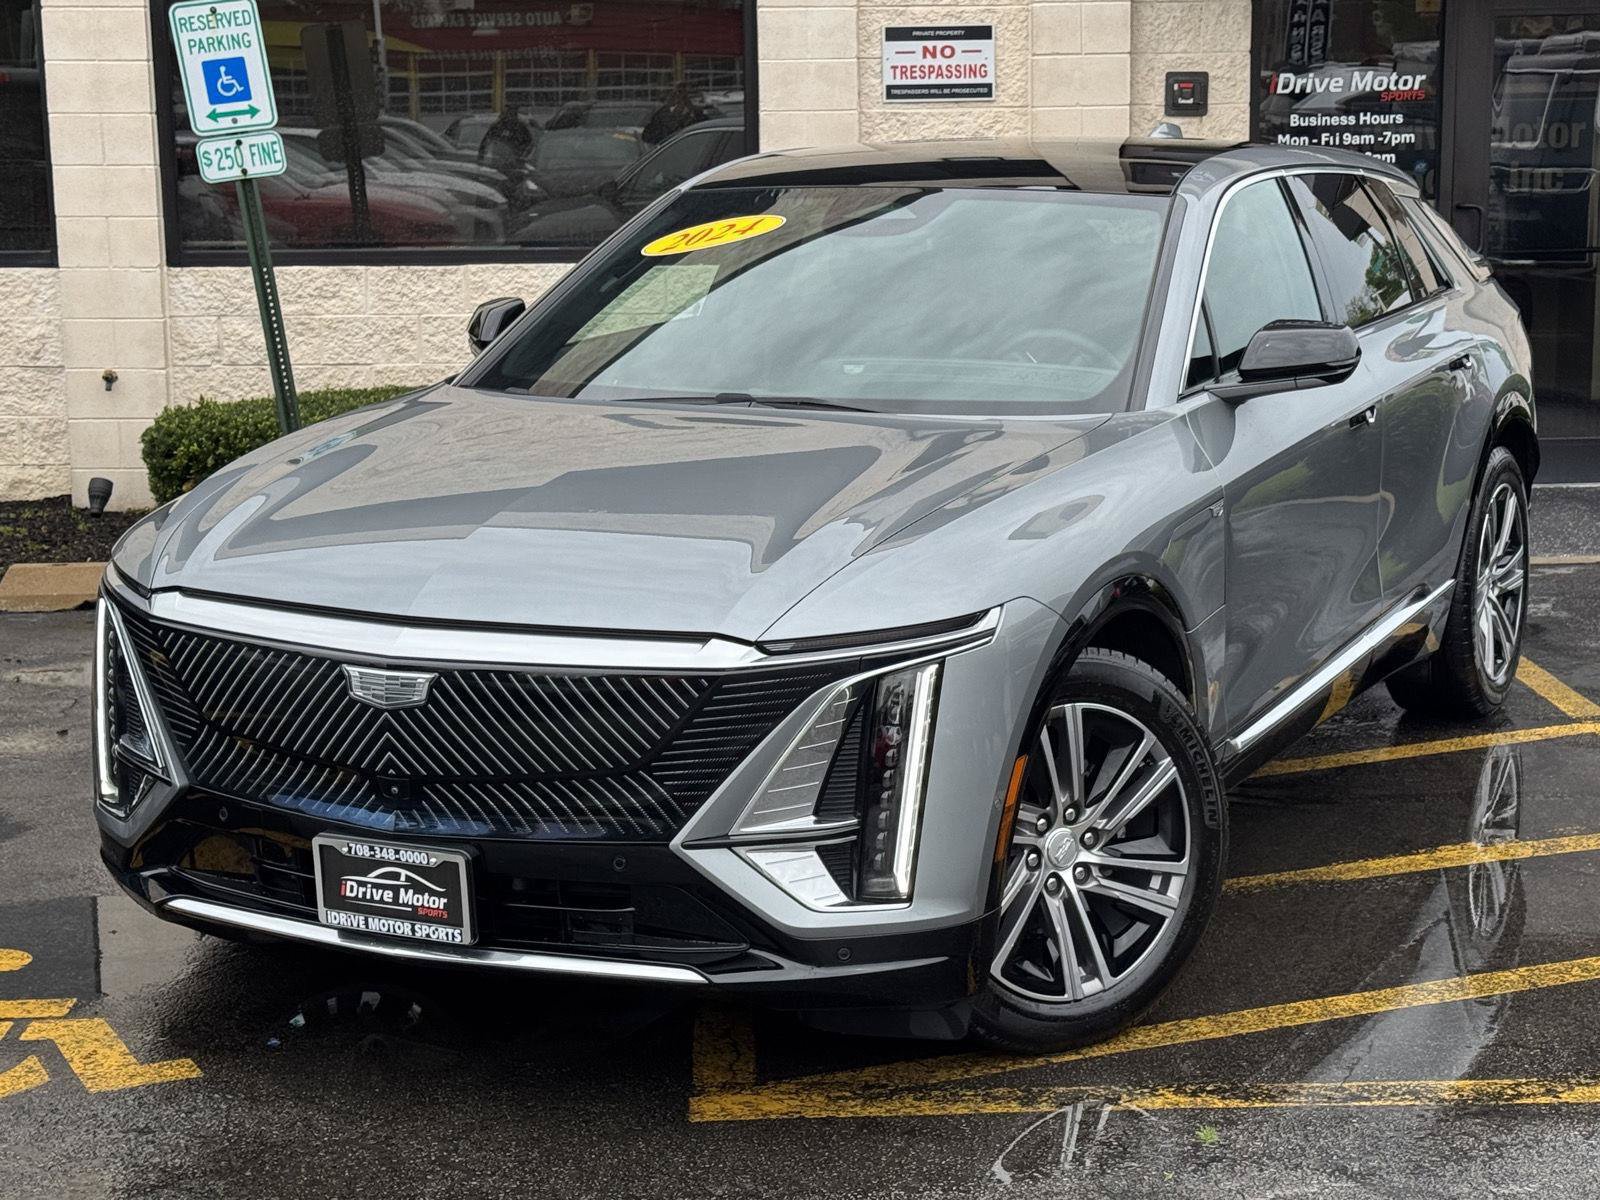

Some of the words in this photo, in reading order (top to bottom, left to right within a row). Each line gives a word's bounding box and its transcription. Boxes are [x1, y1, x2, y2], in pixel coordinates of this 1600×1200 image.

[178, 9, 252, 33] RESERVED
[187, 32, 252, 55] PARKING
[922, 45, 956, 59] NO
[890, 63, 988, 80] TRESPASSING
[1350, 70, 1426, 92] Motor
[1380, 90, 1426, 102] SPORTS
[1289, 113, 1356, 127] Business
[1359, 112, 1404, 126] Hours
[1277, 134, 1309, 146] Mon
[1342, 133, 1375, 146] 9am
[250, 141, 282, 167] FINE
[660, 218, 765, 253] 2024
[1178, 727, 1219, 824] MICHELIN
[349, 843, 428, 865] 708-348-0000
[340, 880, 394, 903] iDrive
[399, 888, 448, 910] Motor
[417, 907, 448, 919] SPORTS
[368, 917, 413, 937] MOTOR
[415, 924, 462, 942] SPORTS
